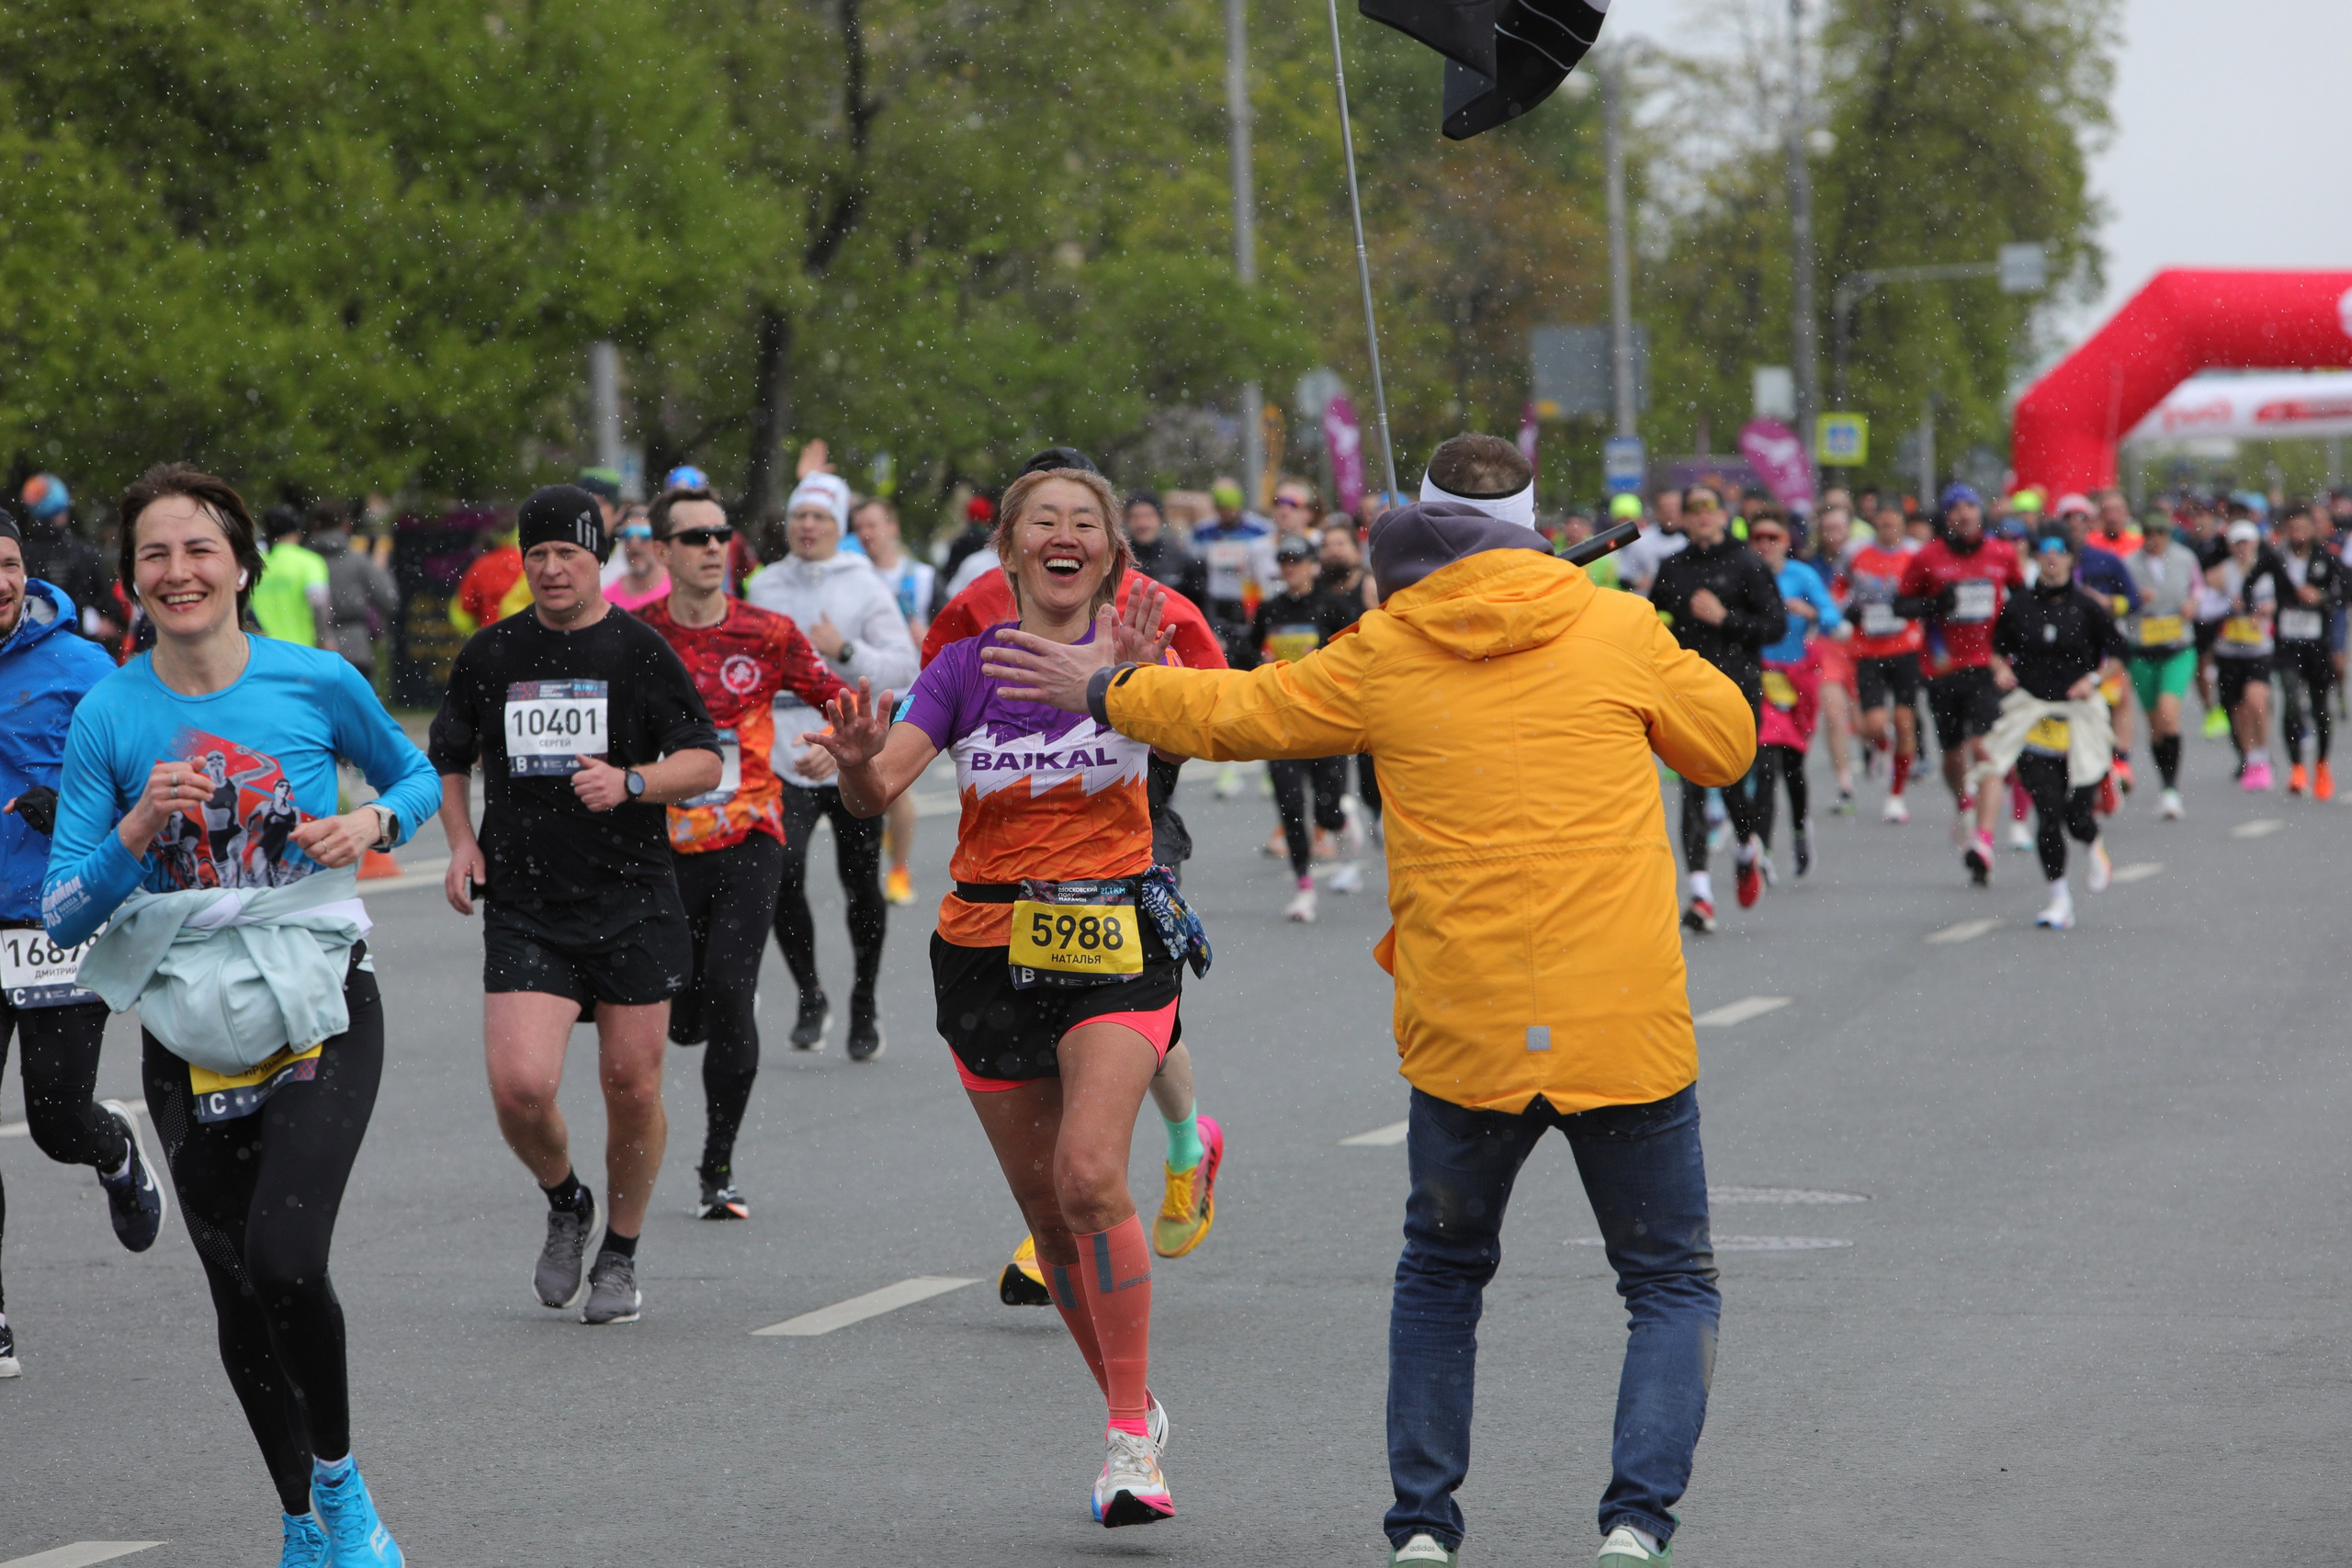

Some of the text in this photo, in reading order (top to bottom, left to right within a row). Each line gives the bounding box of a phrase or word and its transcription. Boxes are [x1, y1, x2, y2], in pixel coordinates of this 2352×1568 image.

[512, 708, 596, 737] 10401
[539, 739, 571, 748] СЕРГЕЙ
[516, 756, 527, 773] B
[971, 748, 1117, 771] BAIKAL
[1032, 912, 1124, 951] 5988
[1051, 953, 1102, 964] НАТАЛЬЯ
[35, 964, 77, 979] ДМИТРИЙ
[1022, 967, 1035, 983] B
[209, 1093, 227, 1114] C
[1409, 1544, 1435, 1552] adidas
